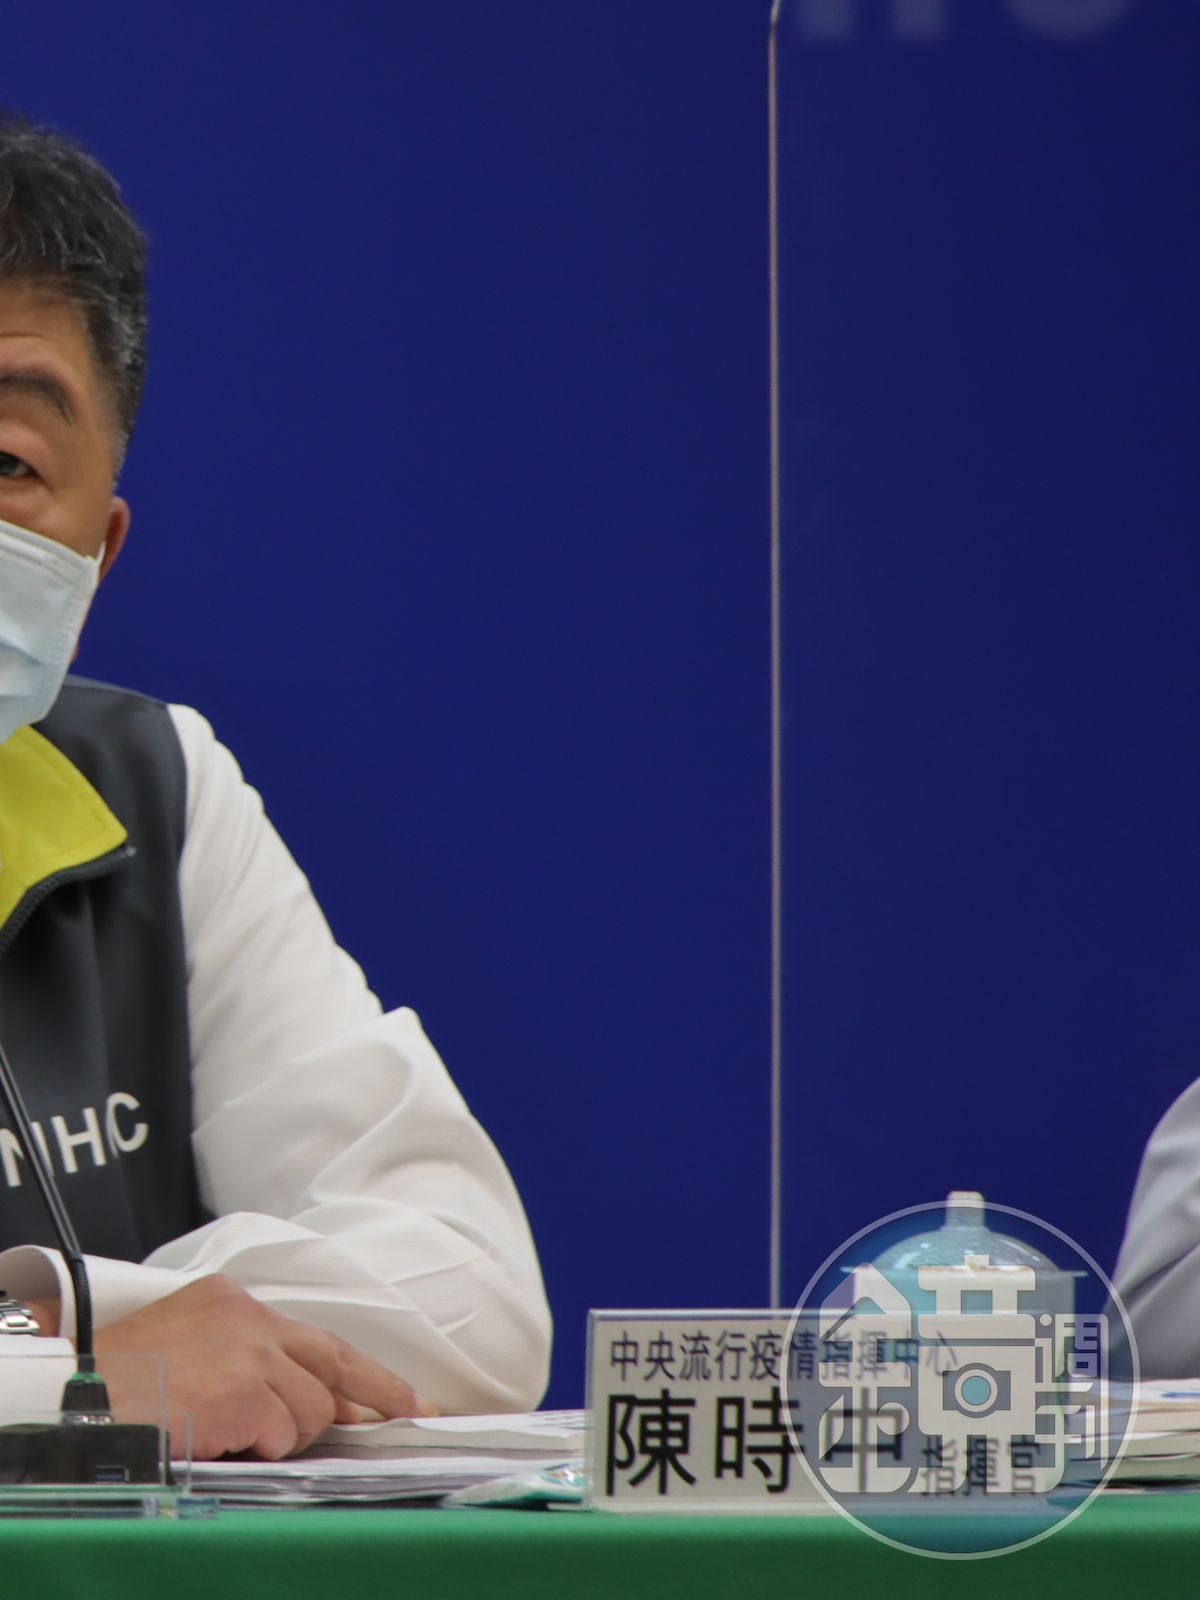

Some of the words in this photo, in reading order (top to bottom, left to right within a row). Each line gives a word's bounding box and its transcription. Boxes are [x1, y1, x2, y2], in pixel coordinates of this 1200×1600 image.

[610, 1329, 959, 1382] 中央流行疫情指揮中心
[607, 1386, 904, 1498] 陳時中
[920, 1434, 1042, 1497] 指揮官
